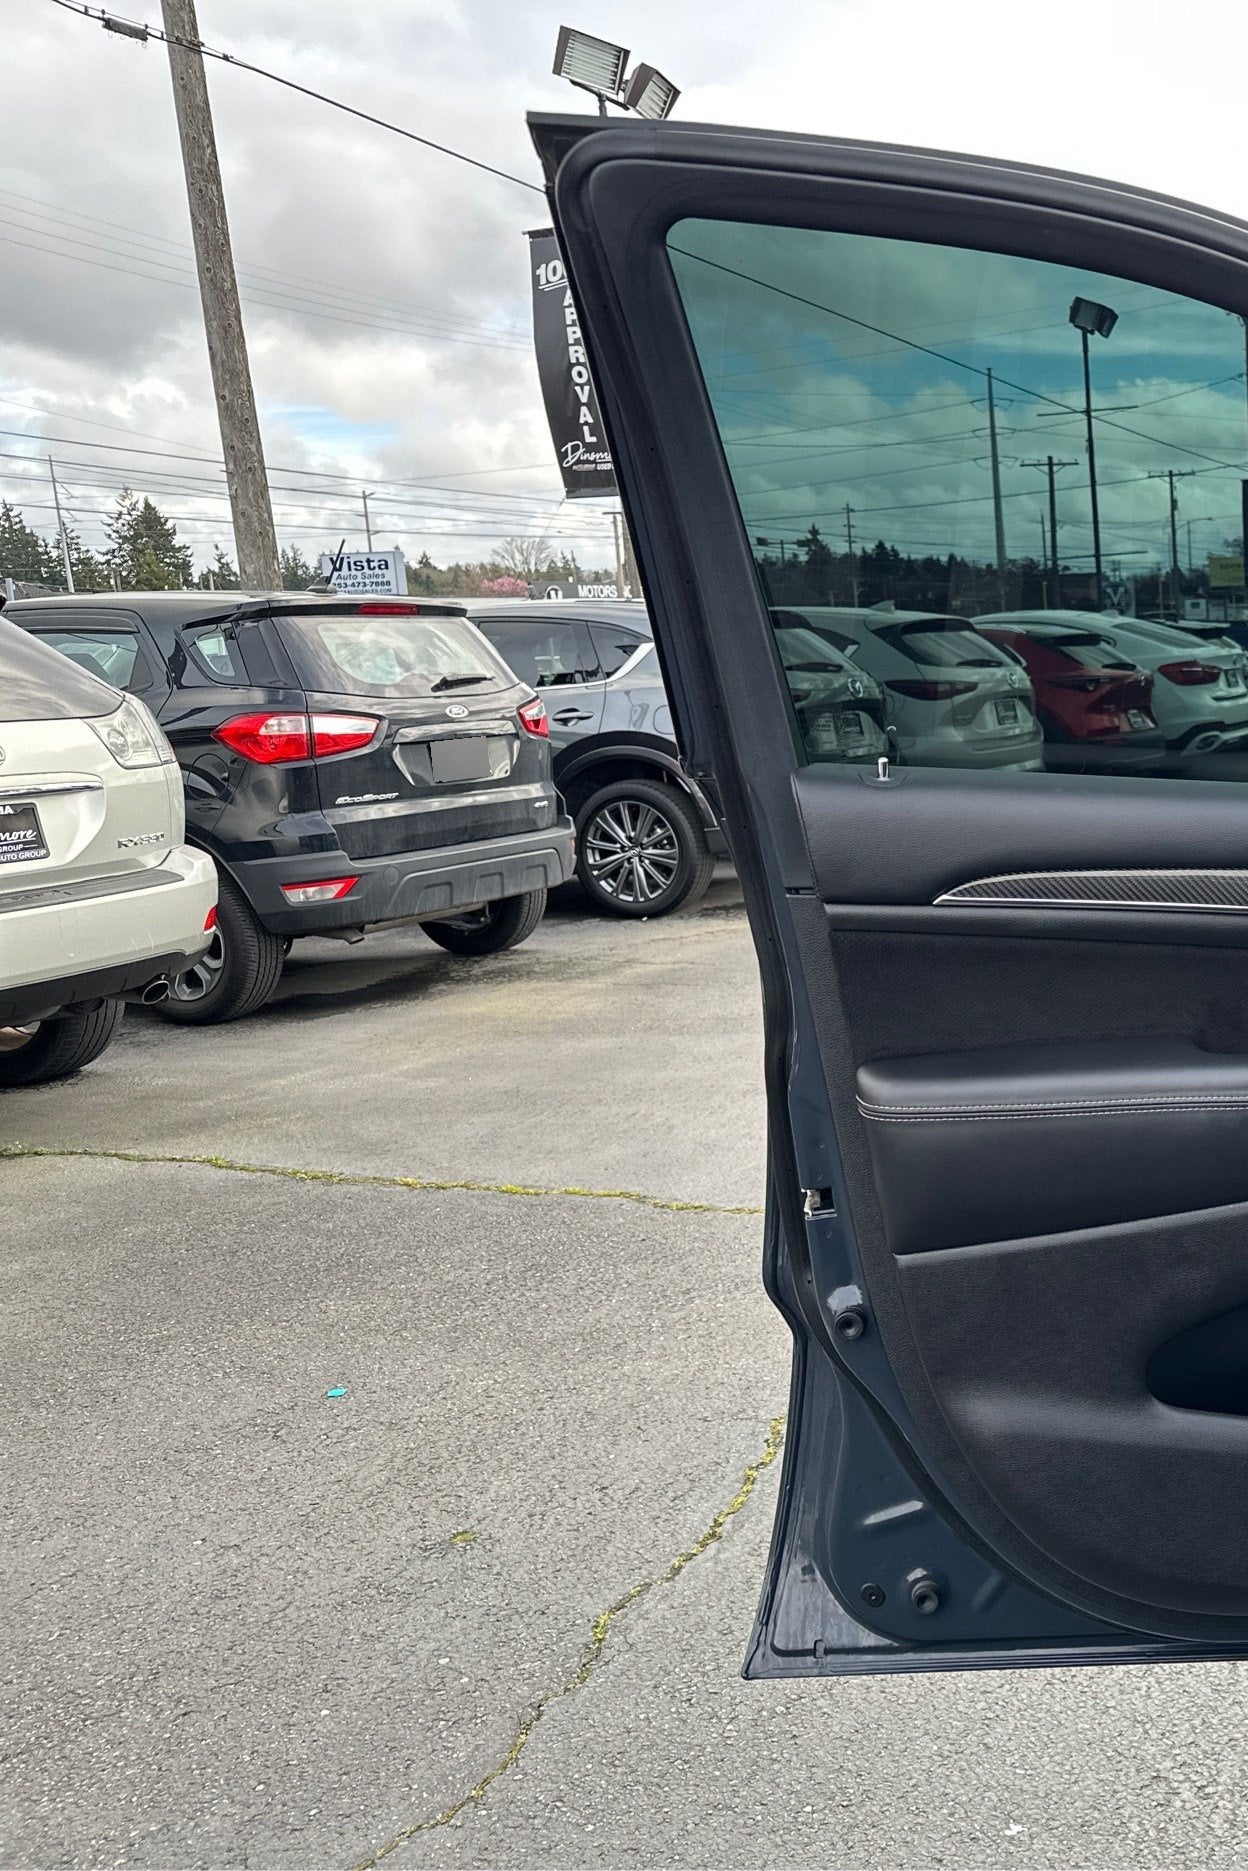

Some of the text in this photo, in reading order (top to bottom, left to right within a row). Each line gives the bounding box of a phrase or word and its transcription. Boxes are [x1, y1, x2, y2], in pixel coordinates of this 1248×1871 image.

[536, 259, 572, 286] 10
[563, 288, 597, 443] APPROVAL
[561, 440, 611, 467] Dinsm
[329, 556, 389, 572] Vista
[335, 571, 386, 581] Auto Sales
[577, 584, 618, 598] MOTORS
[0, 849, 47, 862] UTO GROUP
